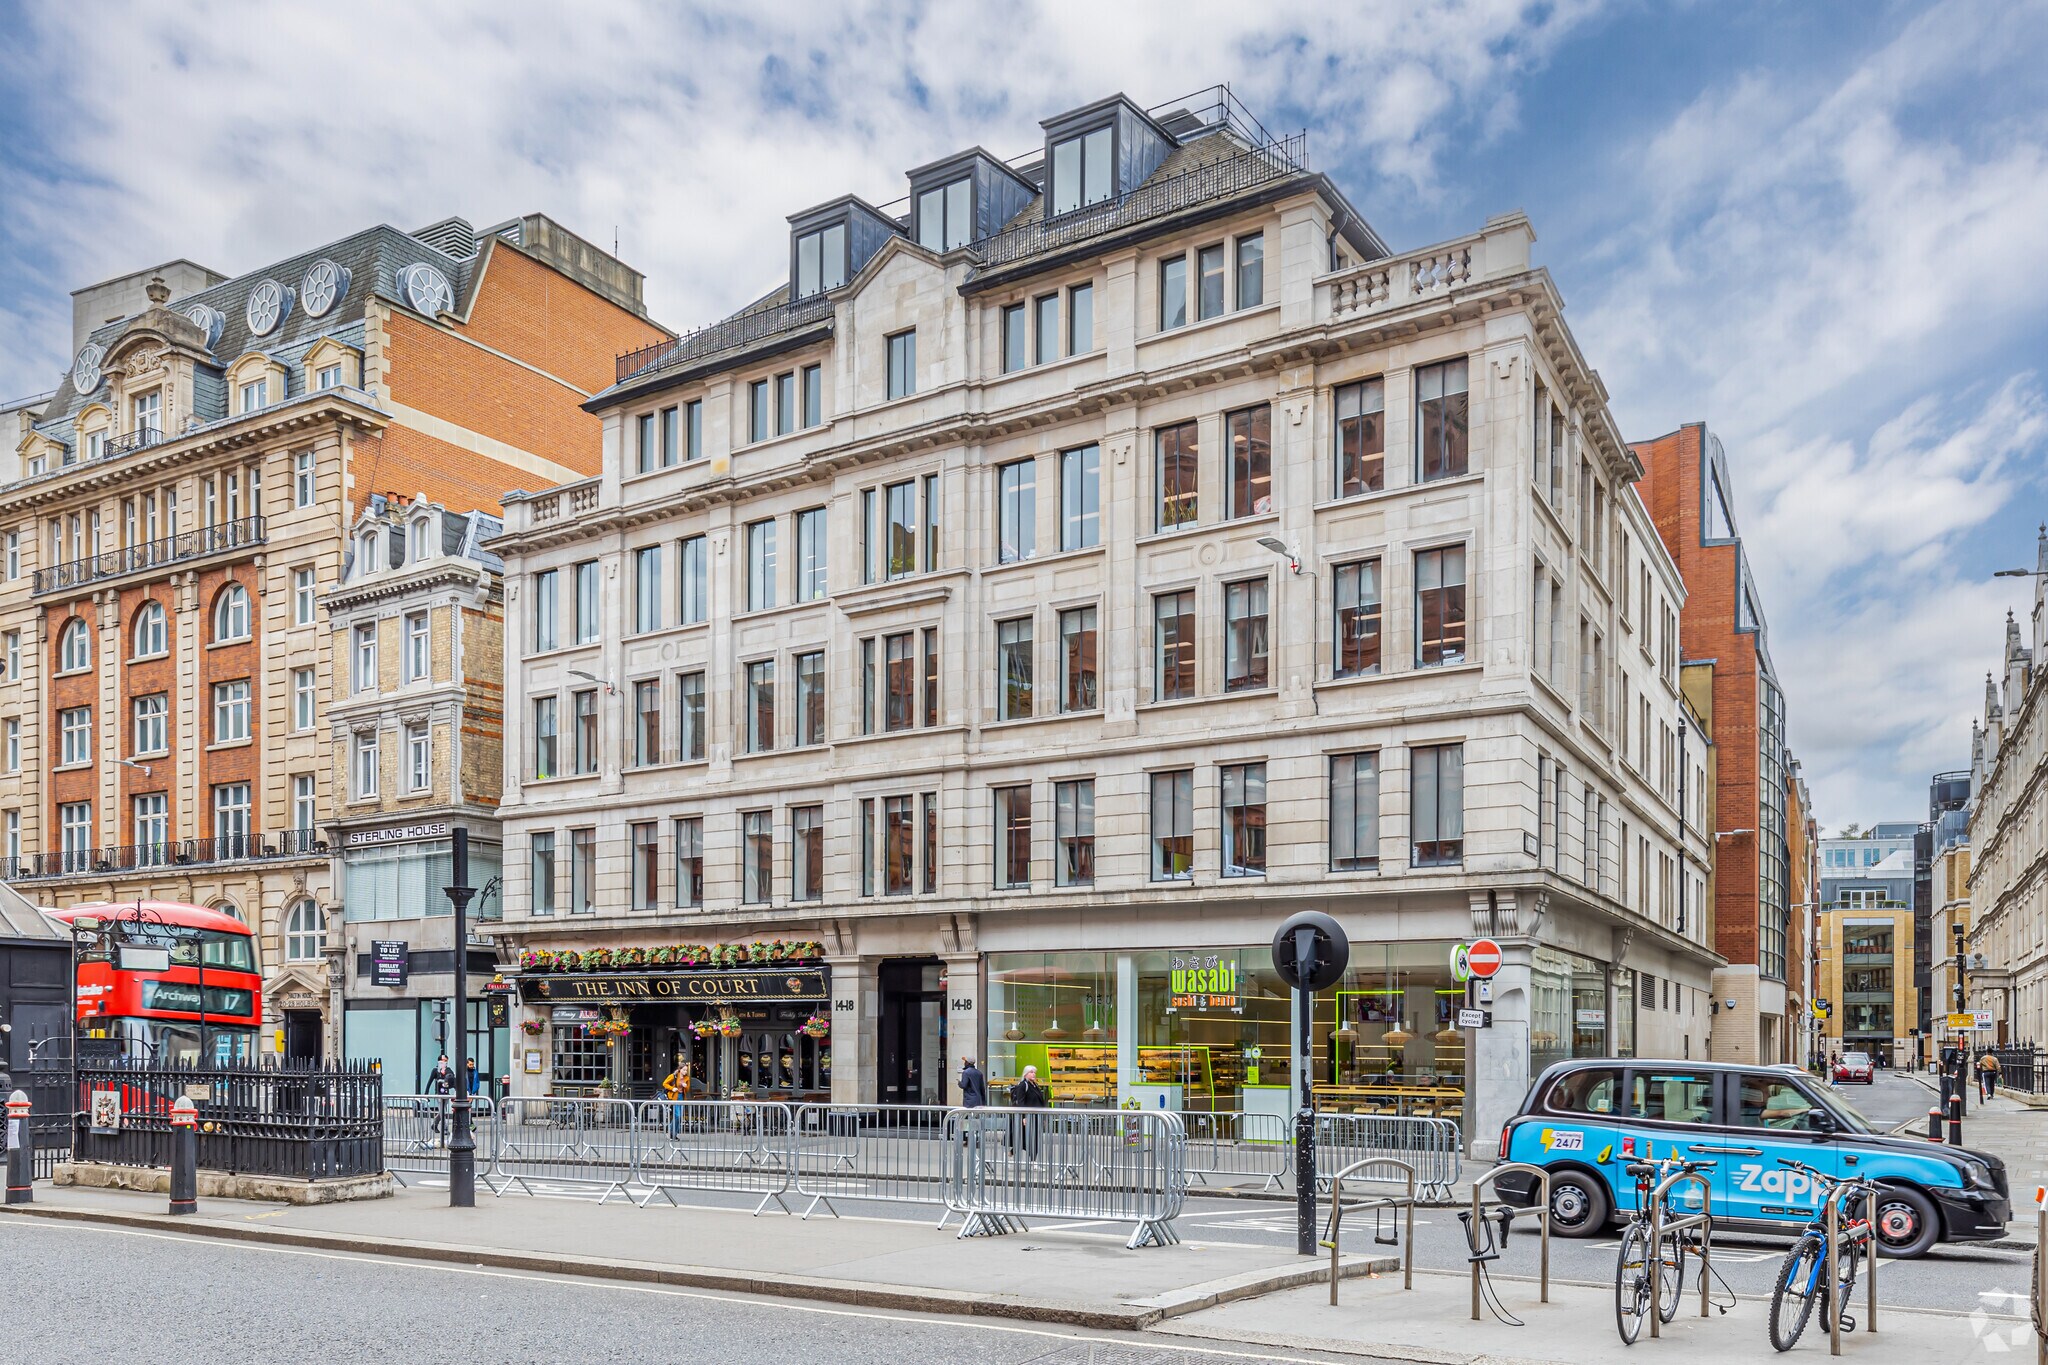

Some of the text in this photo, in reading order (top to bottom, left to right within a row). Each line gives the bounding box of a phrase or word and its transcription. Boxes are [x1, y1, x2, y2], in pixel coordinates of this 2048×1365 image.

[351, 823, 445, 843] STERLING HOUSE
[1172, 954, 1218, 970] わさび
[1171, 960, 1236, 993] wasabi
[572, 979, 759, 996] THE INN OF COURT
[154, 989, 241, 1010] Archway 17
[952, 999, 972, 1011] 14-18
[1171, 994, 1197, 1007] sushi
[1209, 994, 1236, 1007] bento
[1461, 1011, 1481, 1019] Except
[1556, 1138, 1582, 1149] 24/7
